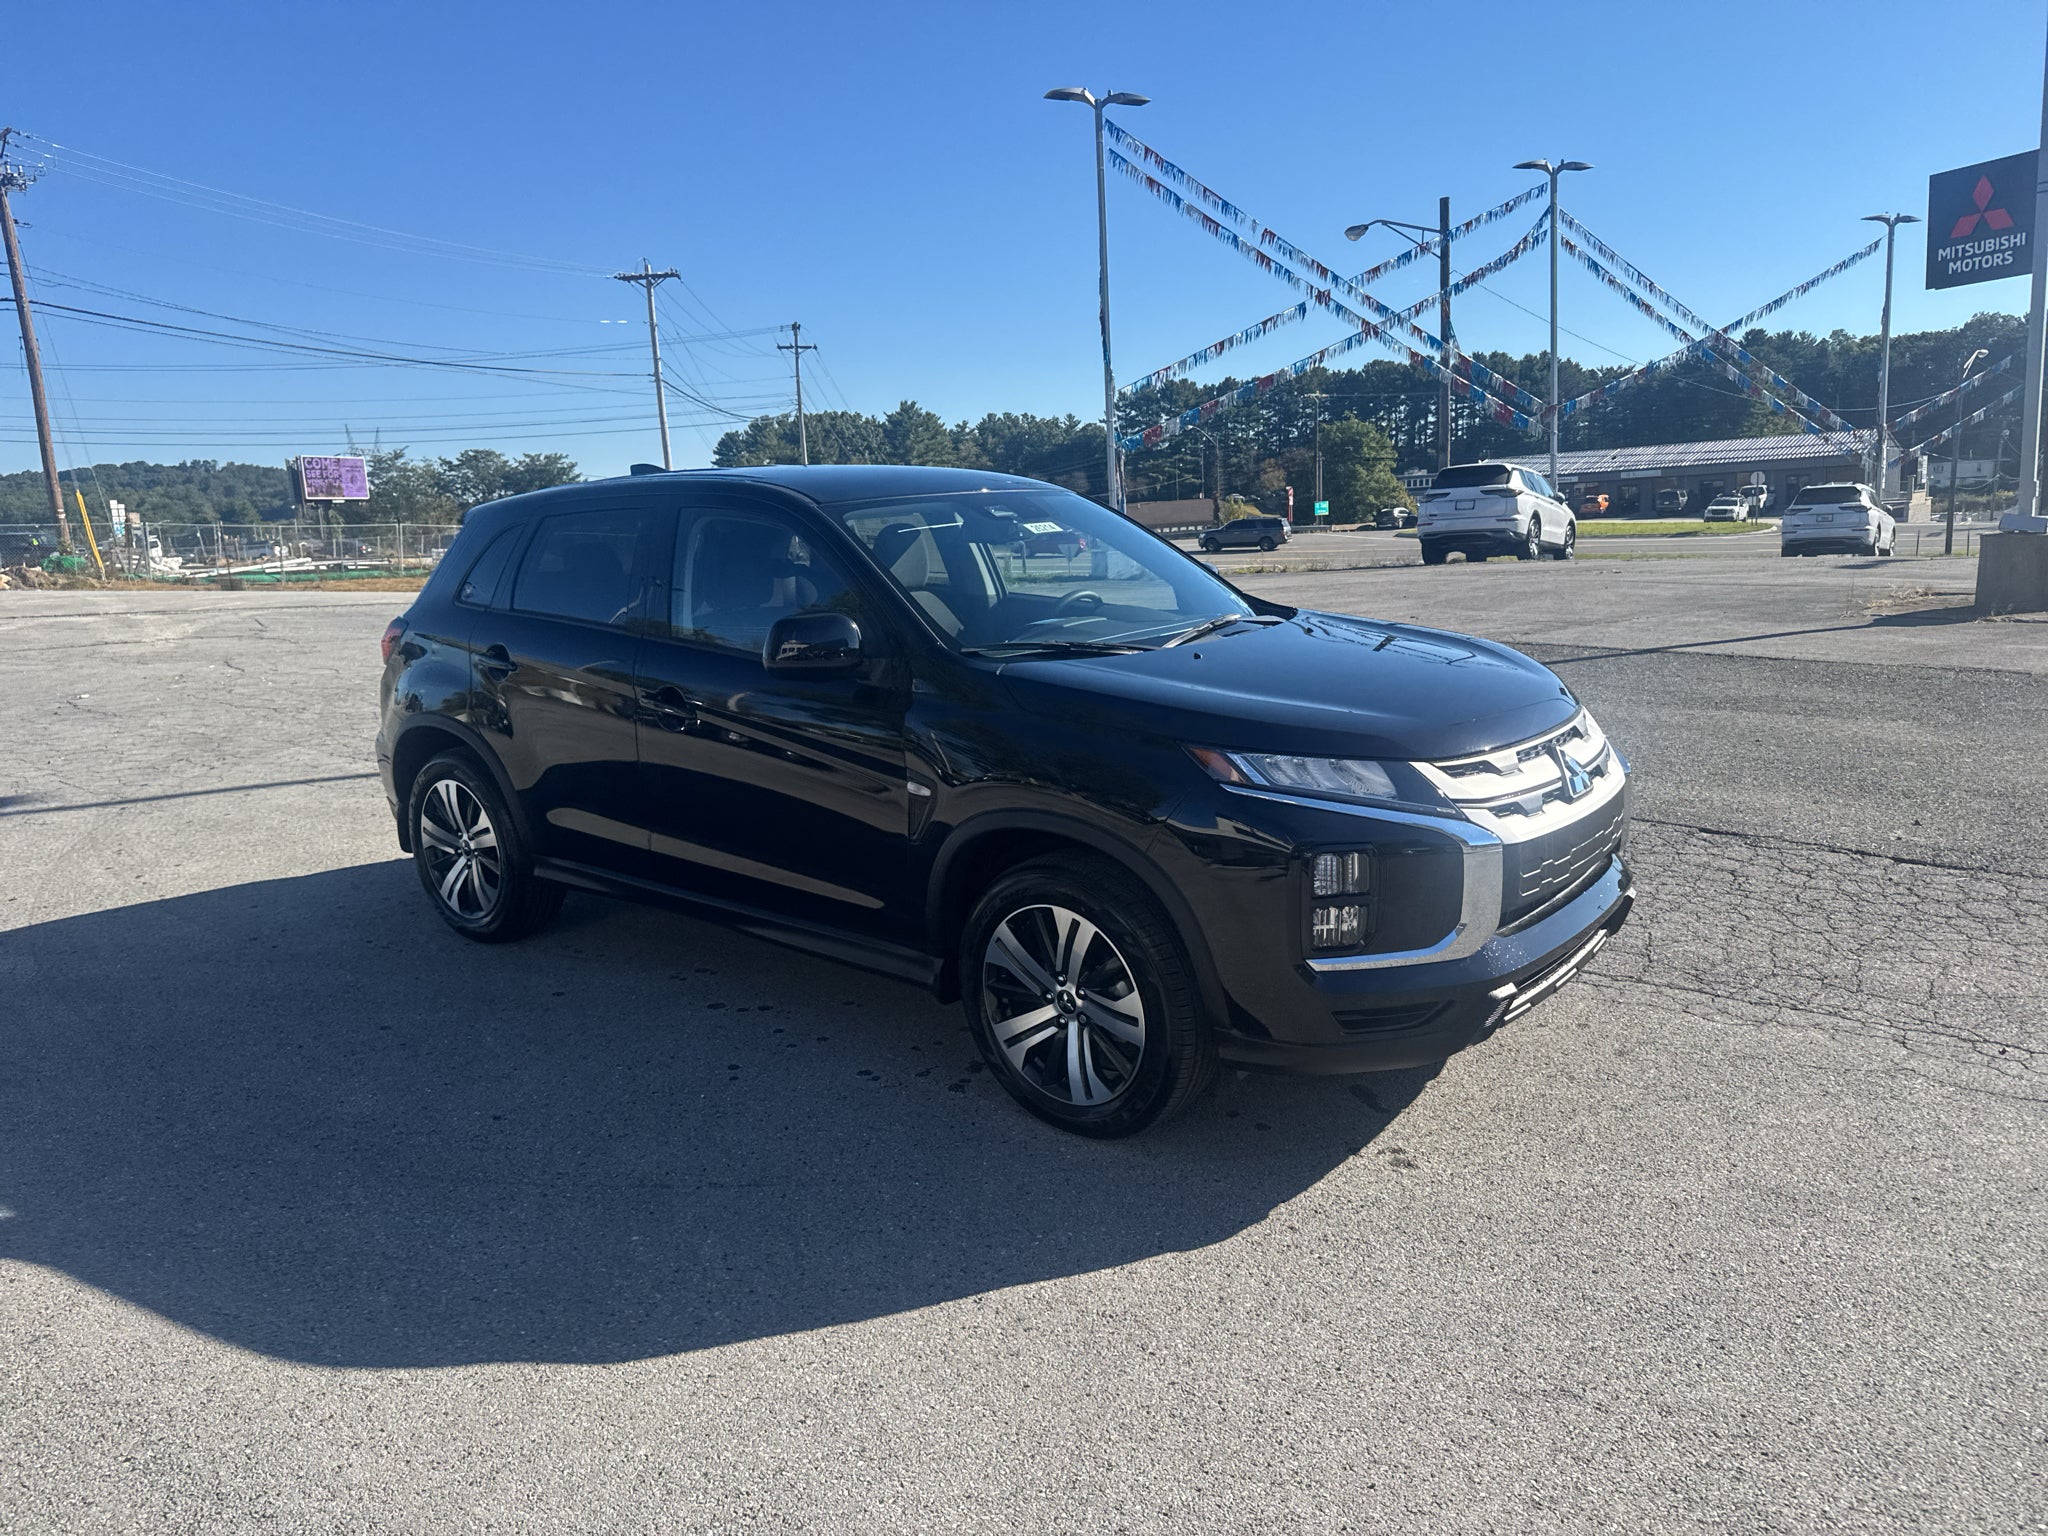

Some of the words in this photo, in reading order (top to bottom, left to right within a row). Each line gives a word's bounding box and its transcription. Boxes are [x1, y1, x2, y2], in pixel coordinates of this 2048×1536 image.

[1938, 232, 2026, 261] MITSUBISHI
[1949, 251, 2013, 274] MOTORS
[304, 458, 339, 469] COME
[306, 470, 321, 478] SEE
[323, 470, 339, 478] FOR
